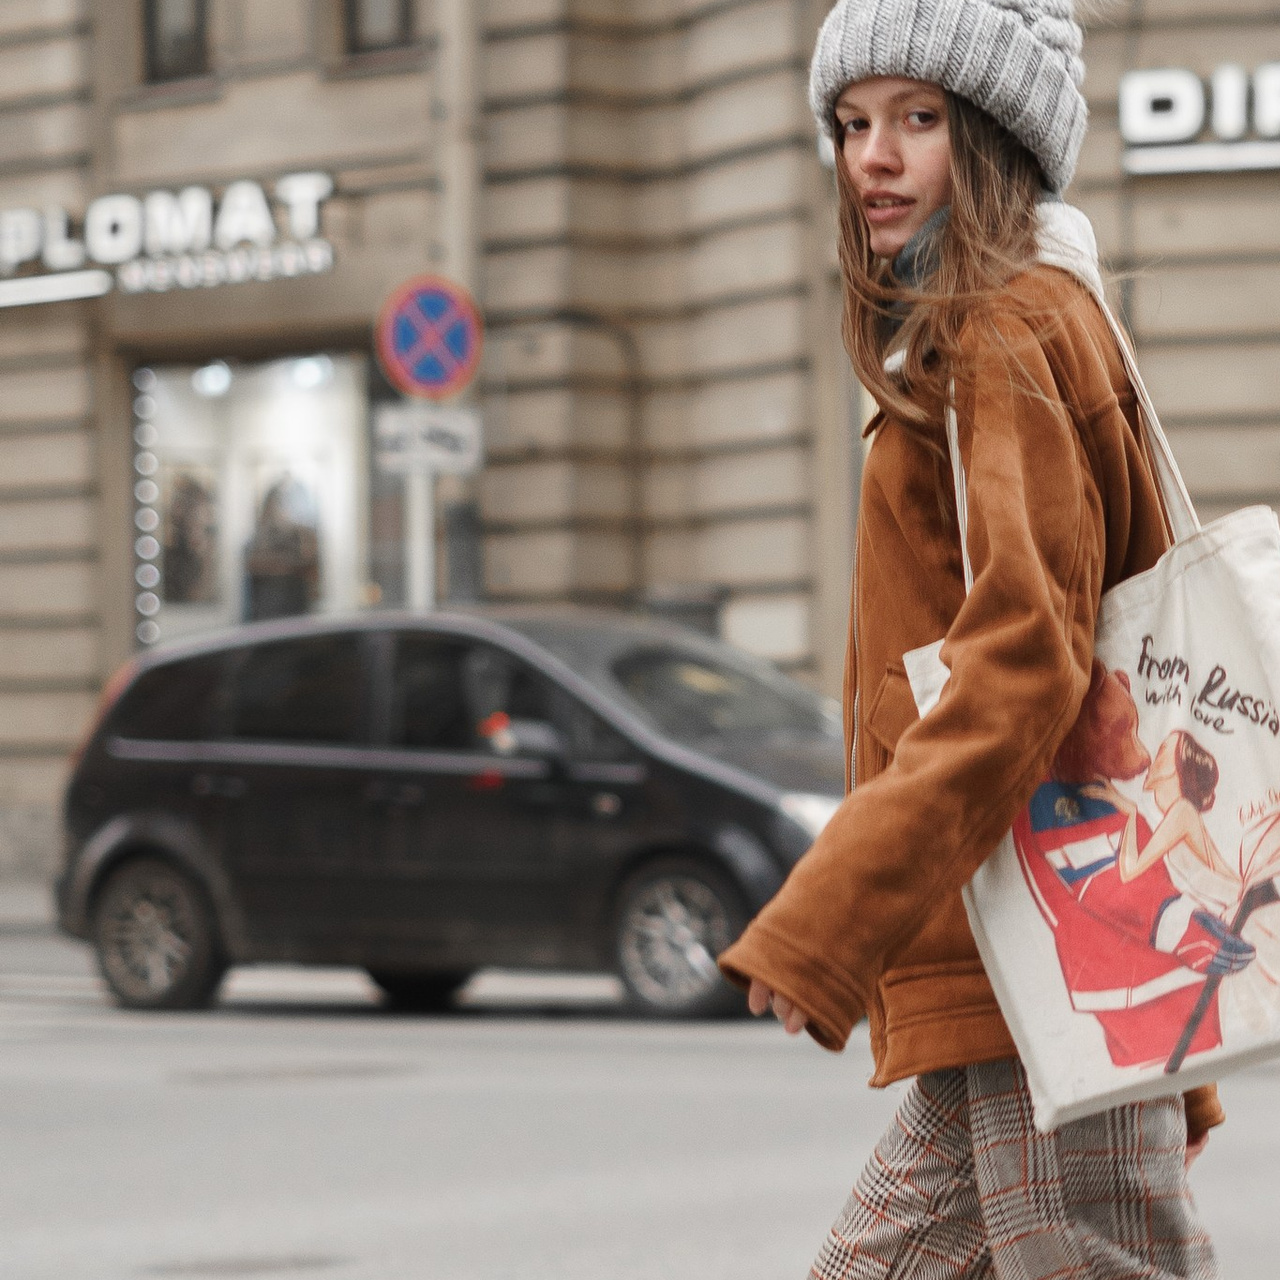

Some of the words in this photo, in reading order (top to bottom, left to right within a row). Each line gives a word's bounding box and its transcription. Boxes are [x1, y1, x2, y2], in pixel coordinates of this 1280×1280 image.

[0, 171, 334, 276] PLOMAT
[1145, 681, 1181, 706] with
[1190, 693, 1234, 734] love
[1197, 663, 1280, 736] Russia
